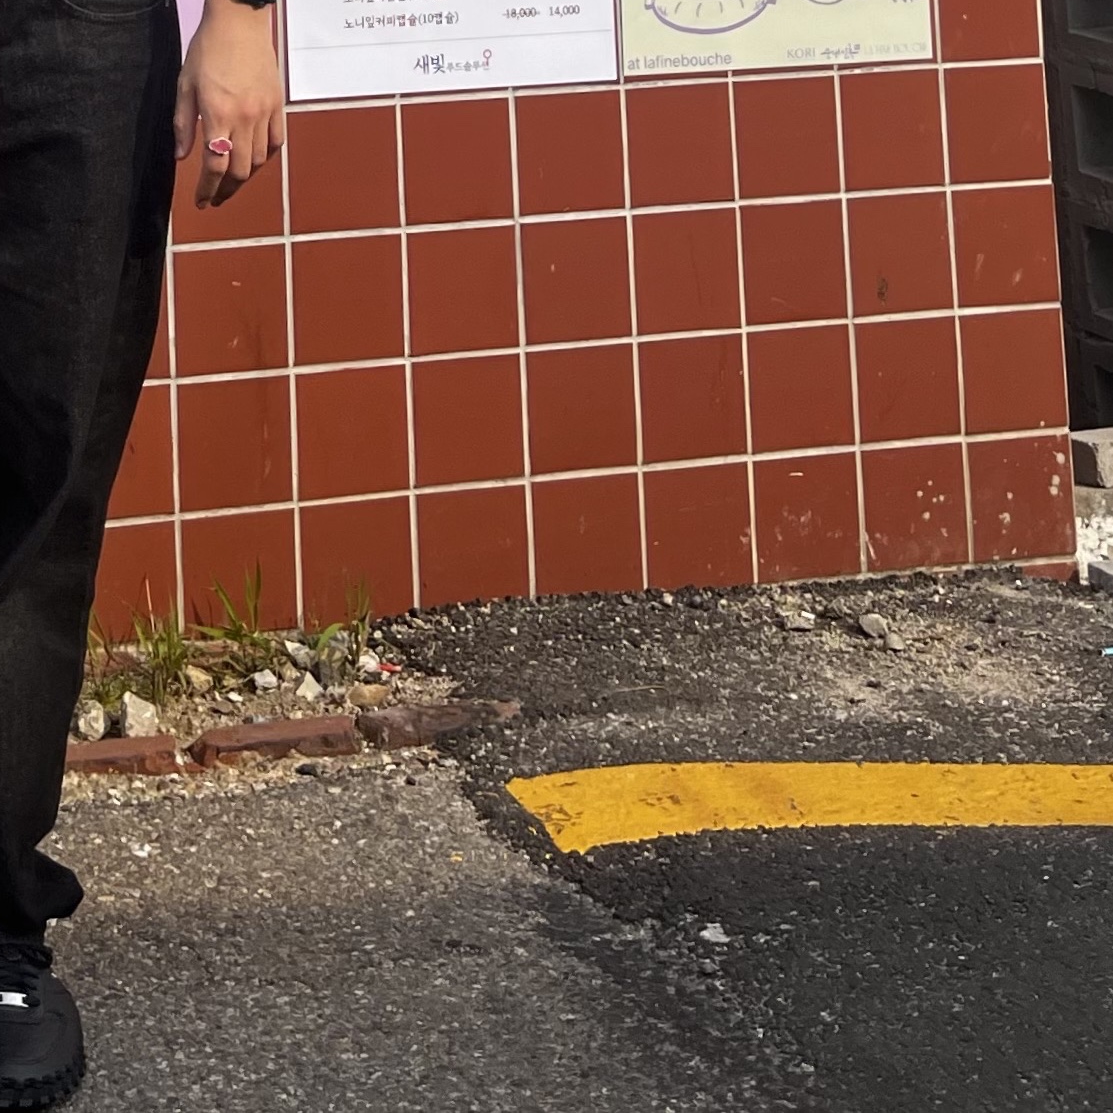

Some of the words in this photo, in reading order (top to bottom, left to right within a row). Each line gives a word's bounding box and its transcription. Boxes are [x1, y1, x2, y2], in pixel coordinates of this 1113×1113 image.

[550, 5, 580, 17] 14,000
[787, 48, 816, 59] KORI
[627, 57, 640, 70] at
[644, 53, 732, 69] lafinebouche
